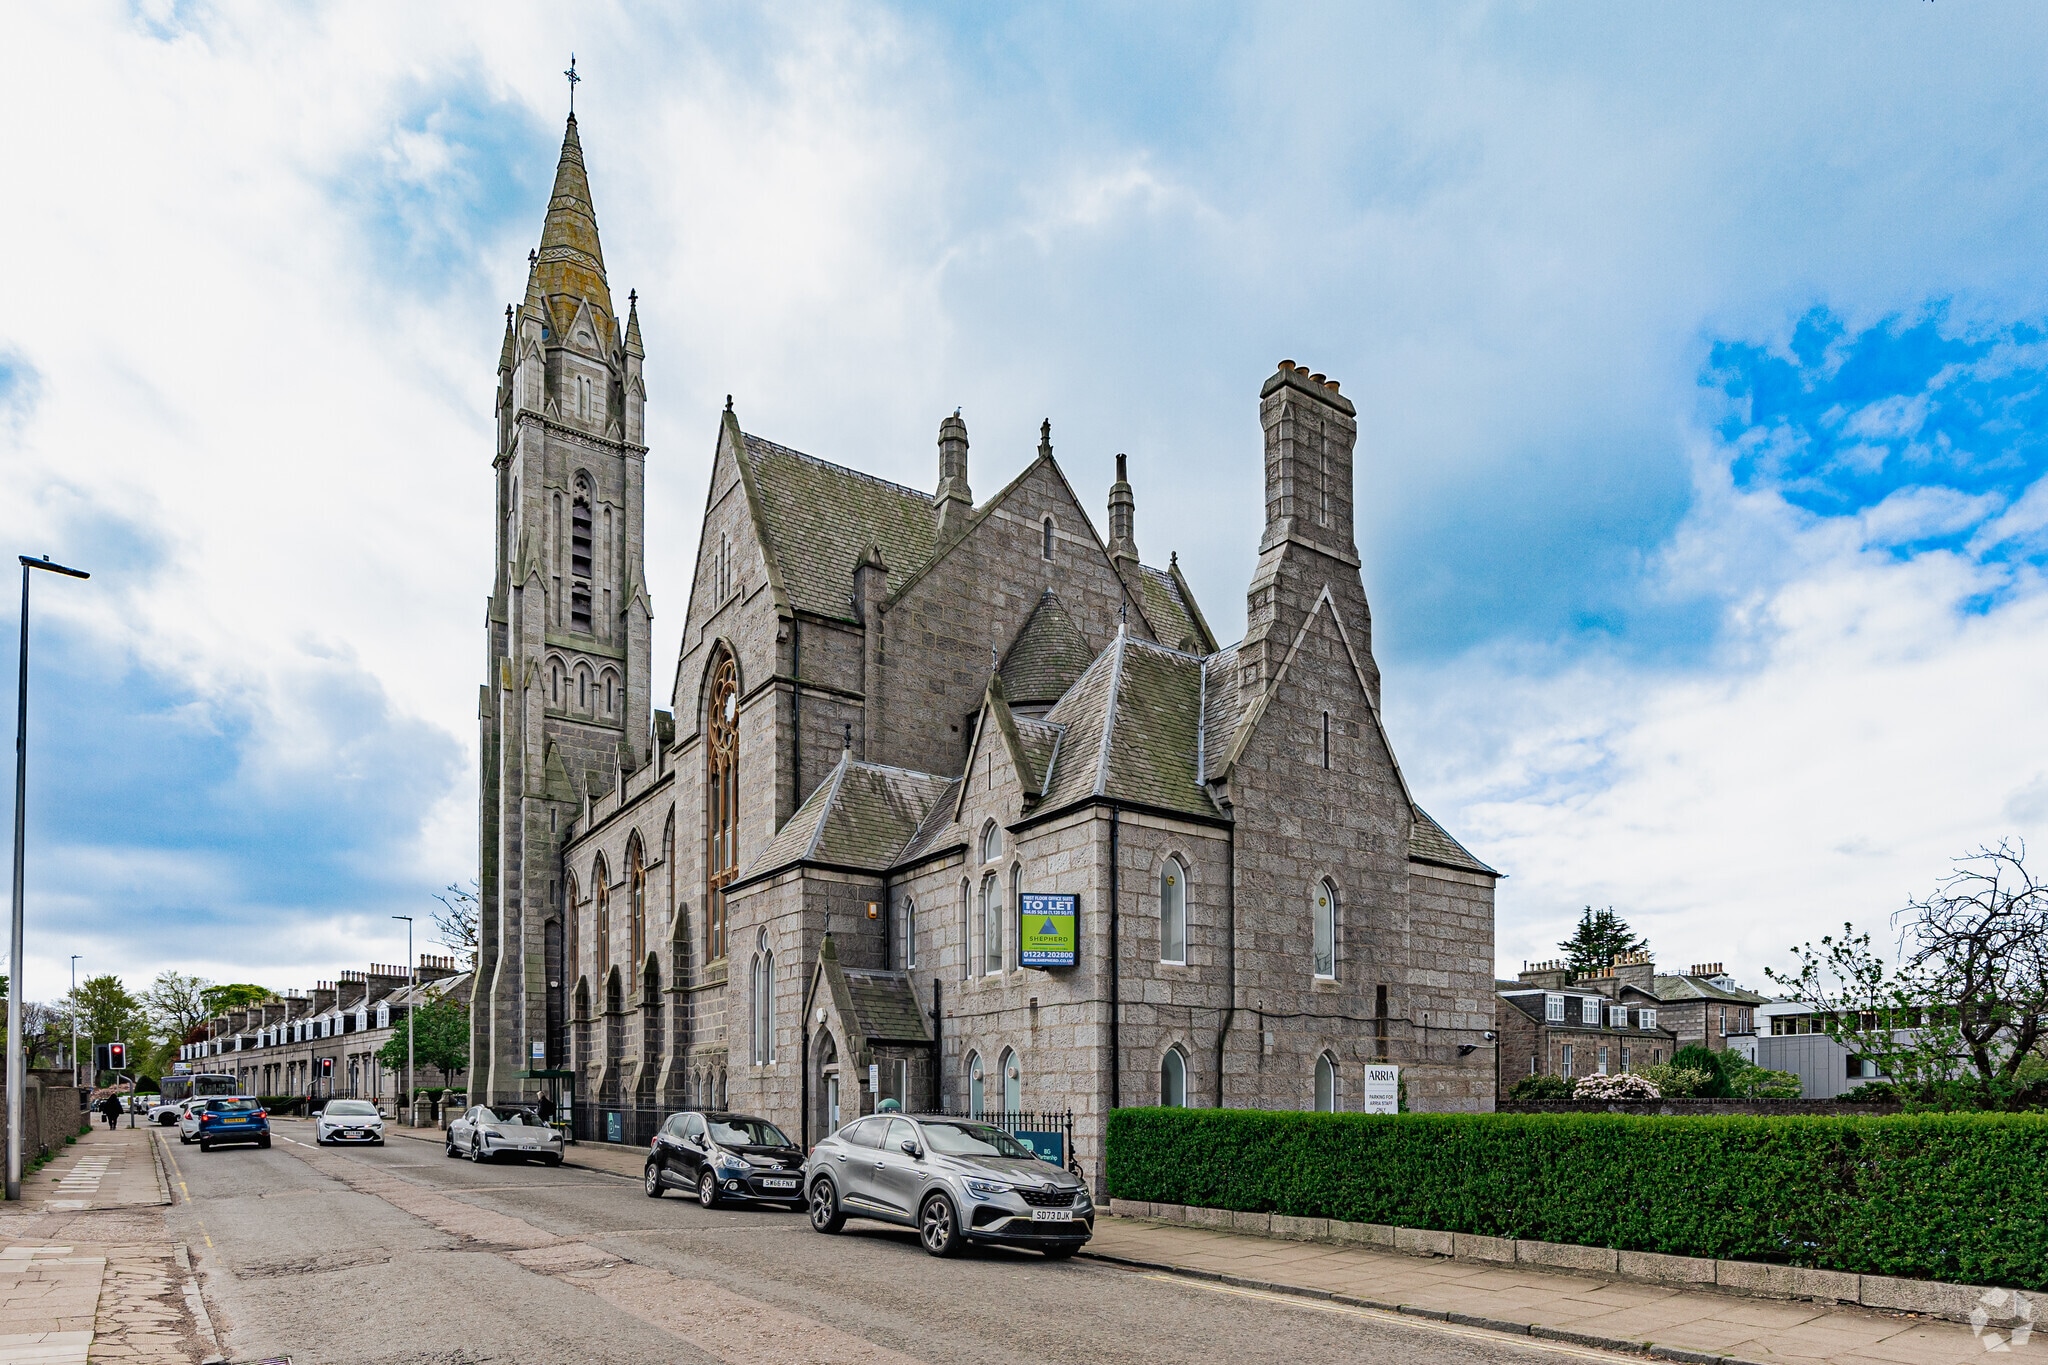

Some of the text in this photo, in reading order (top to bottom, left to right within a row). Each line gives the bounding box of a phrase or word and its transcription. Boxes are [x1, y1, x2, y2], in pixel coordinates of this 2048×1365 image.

[1023, 901, 1073, 911] TO LET
[1369, 1070, 1395, 1081] ARRIA
[1036, 1210, 1071, 1220] SD73 DJK
